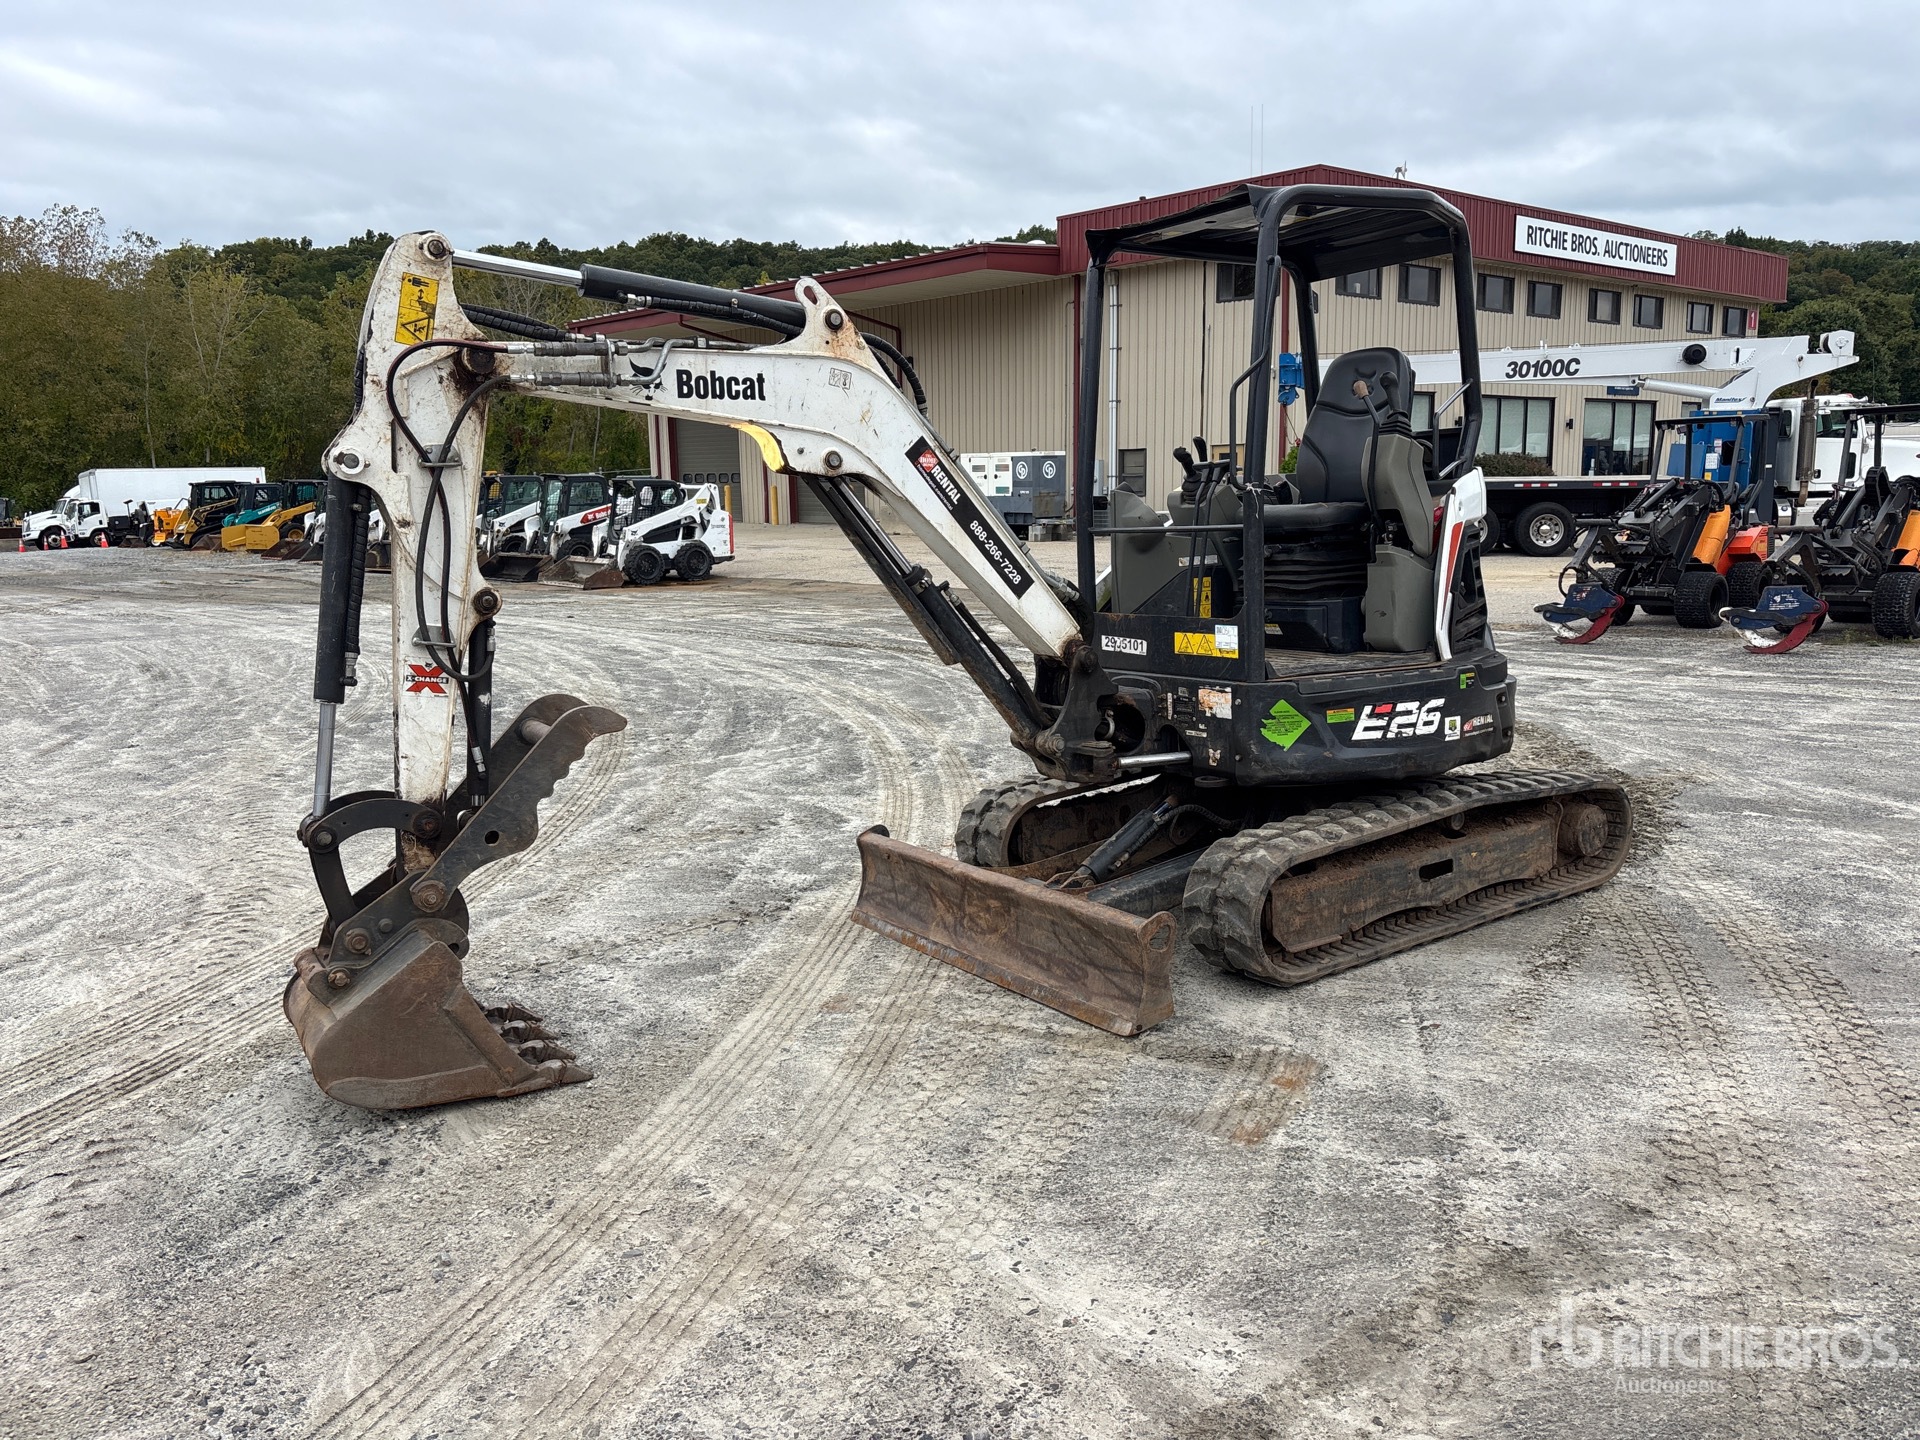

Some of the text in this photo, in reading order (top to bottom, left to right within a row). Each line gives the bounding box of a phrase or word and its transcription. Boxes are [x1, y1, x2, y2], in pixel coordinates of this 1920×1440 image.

[1527, 225, 1668, 267] RITCHIE BROS. AUCTIONEERS
[677, 369, 766, 401] Bobcat
[1505, 357, 1580, 379] 30100C
[931, 465, 961, 505] RENTAL
[970, 520, 1021, 585] 888-266-7228
